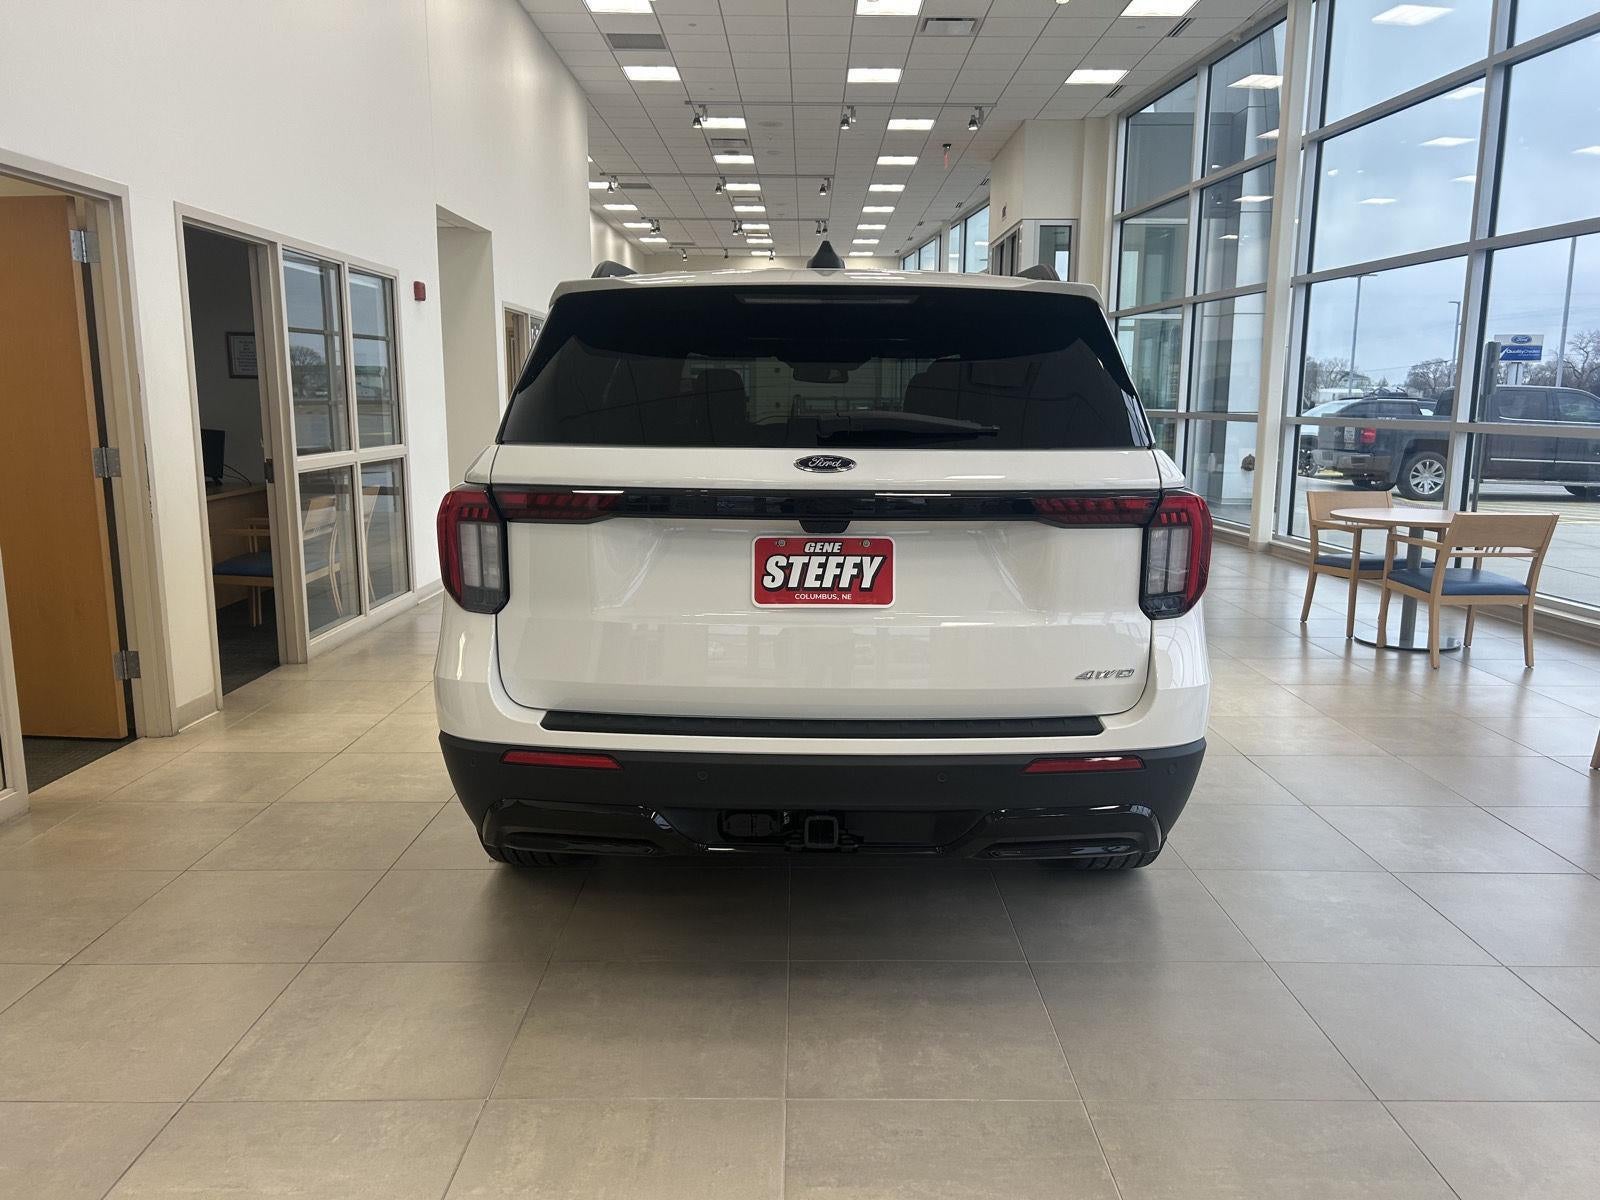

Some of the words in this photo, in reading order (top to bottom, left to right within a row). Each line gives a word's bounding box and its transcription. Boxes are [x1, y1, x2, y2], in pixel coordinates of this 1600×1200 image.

[808, 457, 842, 468] Ford
[804, 541, 843, 553] GENE
[762, 554, 885, 590] STEFFY
[794, 593, 840, 601] COLUMBUS,
[1075, 668, 1135, 680] 4WD
